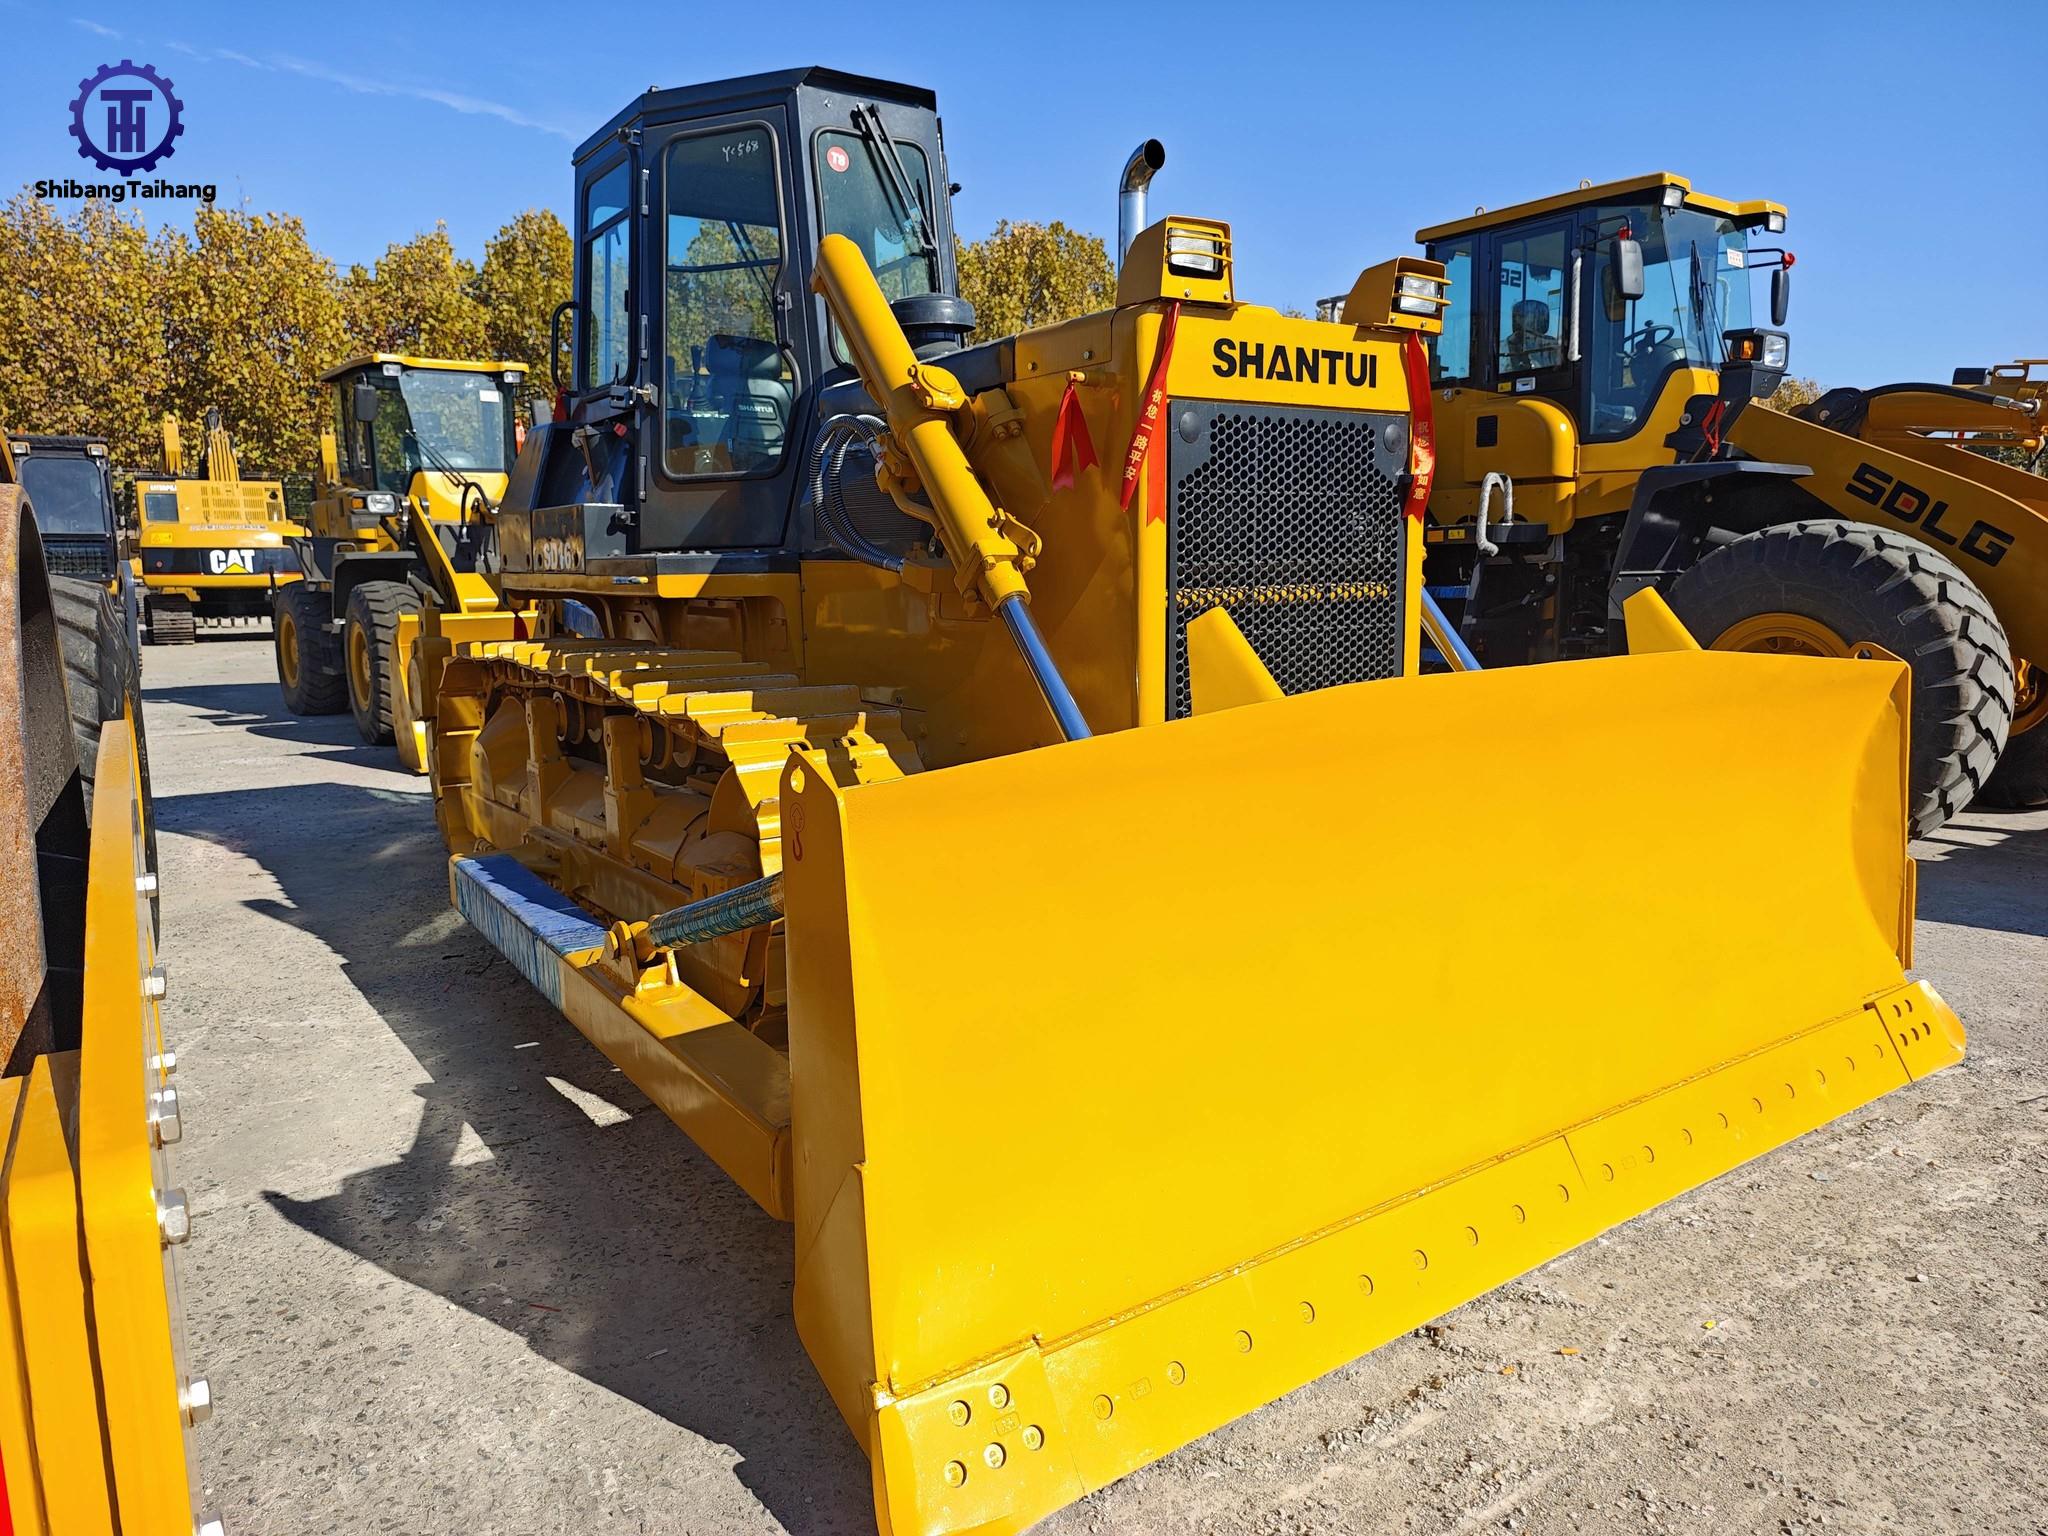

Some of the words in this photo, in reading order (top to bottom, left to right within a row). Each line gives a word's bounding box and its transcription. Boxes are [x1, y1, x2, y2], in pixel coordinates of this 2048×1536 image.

[1212, 338, 1377, 388] SHANTUI
[1123, 388, 1163, 480] 祝您一路平安
[1845, 462, 2015, 567] SDLG
[209, 549, 255, 574] CAT
